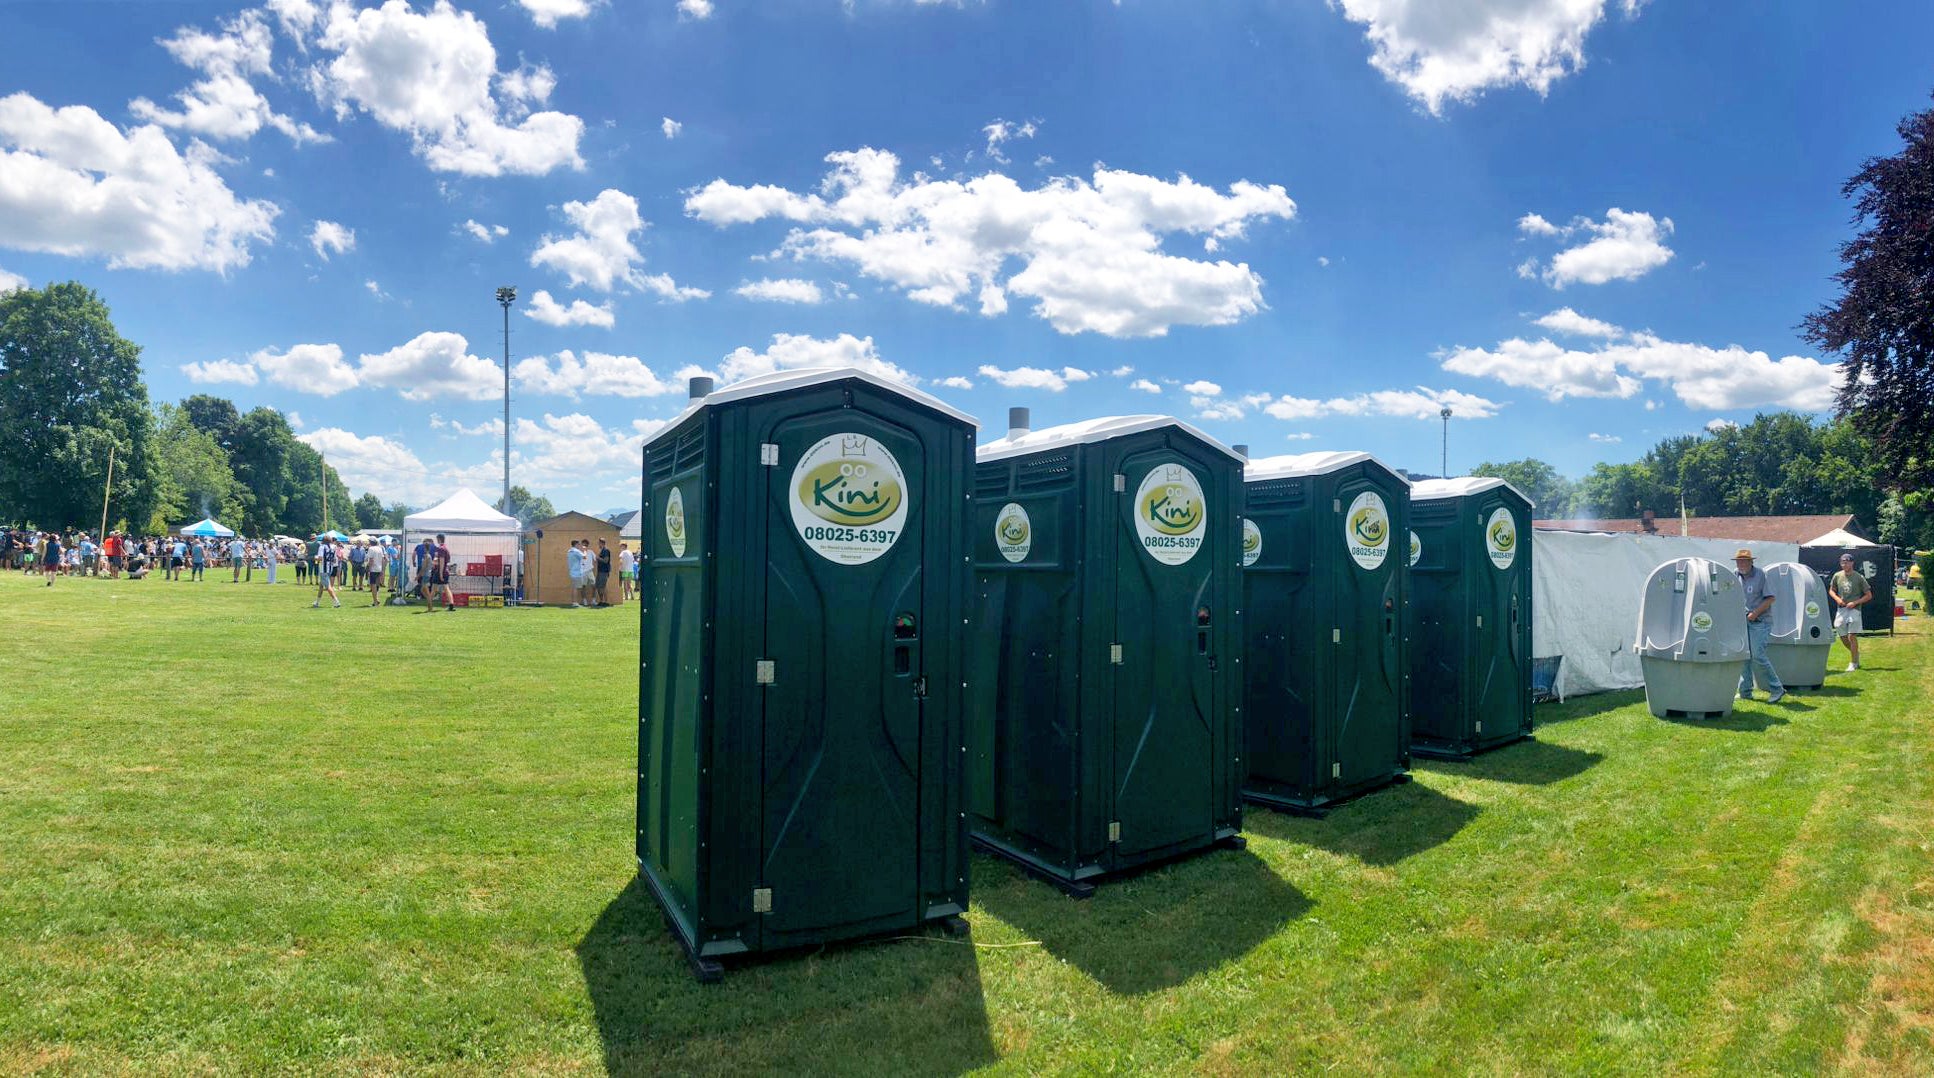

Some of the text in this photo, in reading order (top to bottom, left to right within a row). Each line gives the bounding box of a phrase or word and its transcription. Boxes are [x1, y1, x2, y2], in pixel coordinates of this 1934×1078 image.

[813, 475, 890, 517] Kini
[1150, 496, 1197, 528] Kini
[804, 526, 896, 543] 08025-6397
[1145, 536, 1200, 548] 08025-6397
